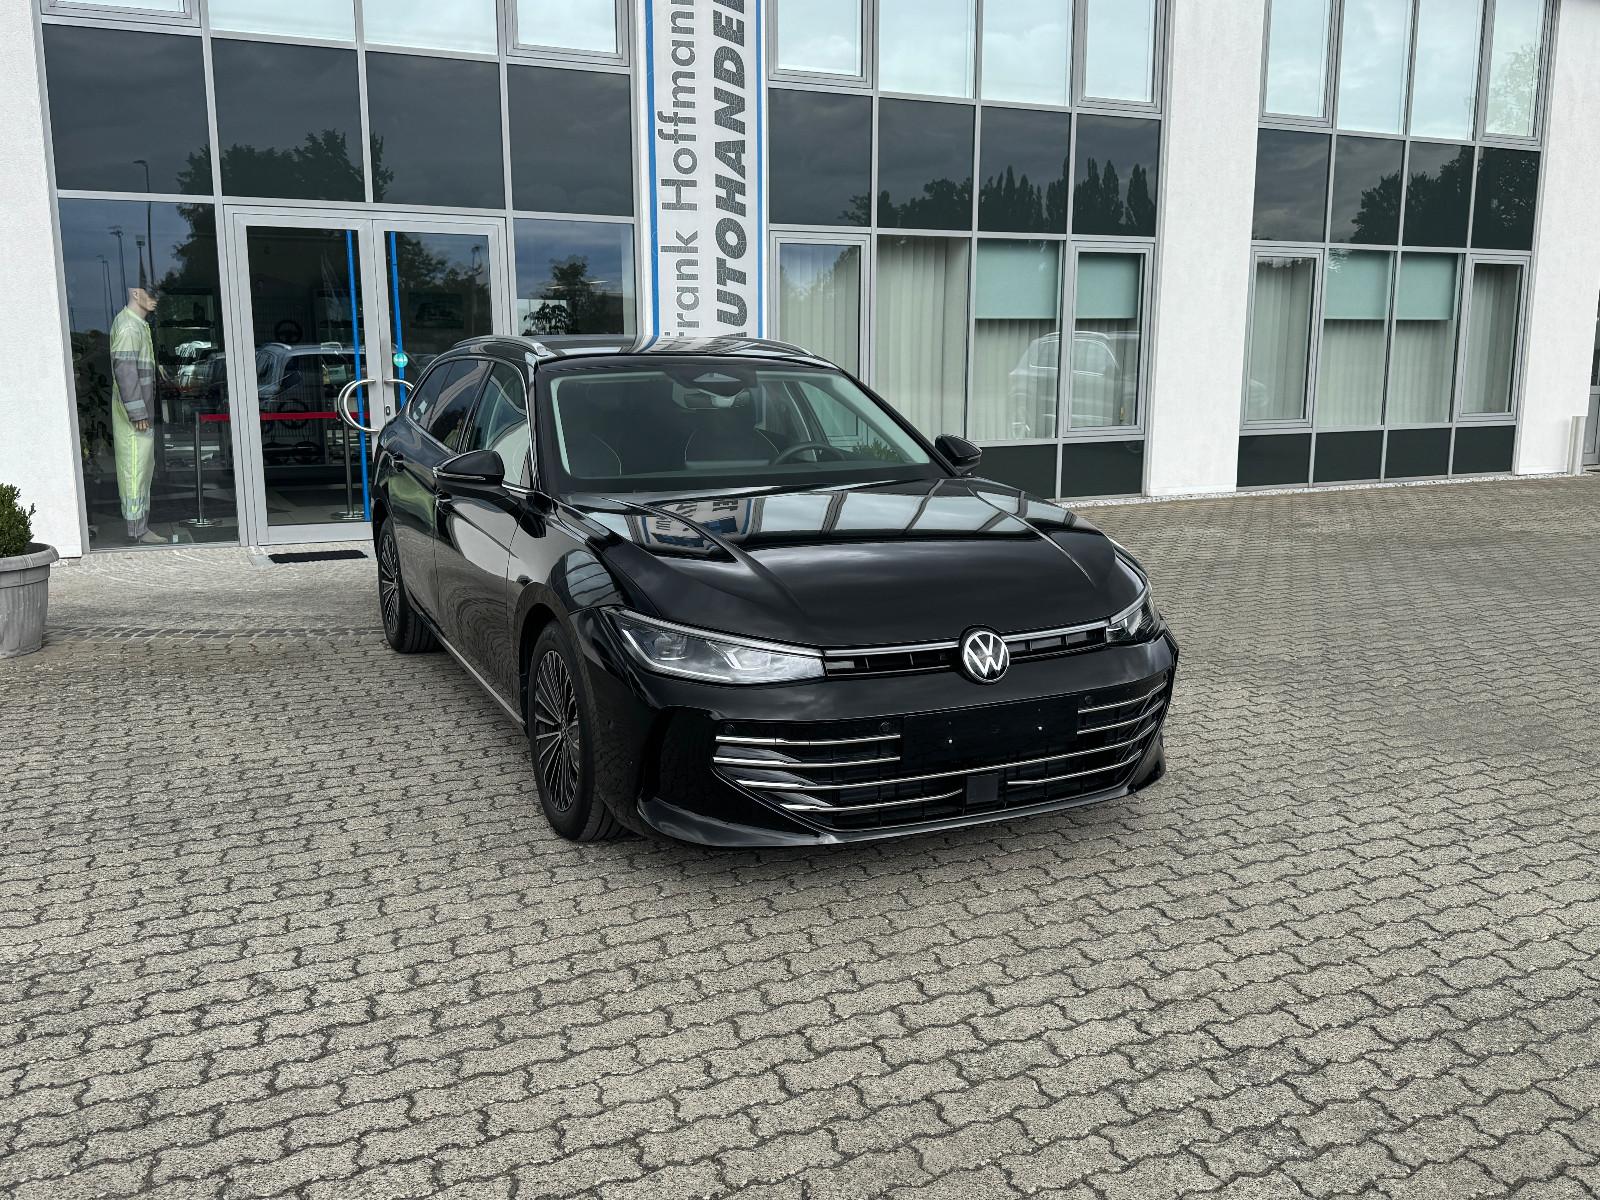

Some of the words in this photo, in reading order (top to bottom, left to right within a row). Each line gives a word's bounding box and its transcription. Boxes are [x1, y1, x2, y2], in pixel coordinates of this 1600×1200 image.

[712, 0, 748, 337] UTOHANDE
[660, 230, 699, 336] rank
[964, 632, 1008, 680] VW
